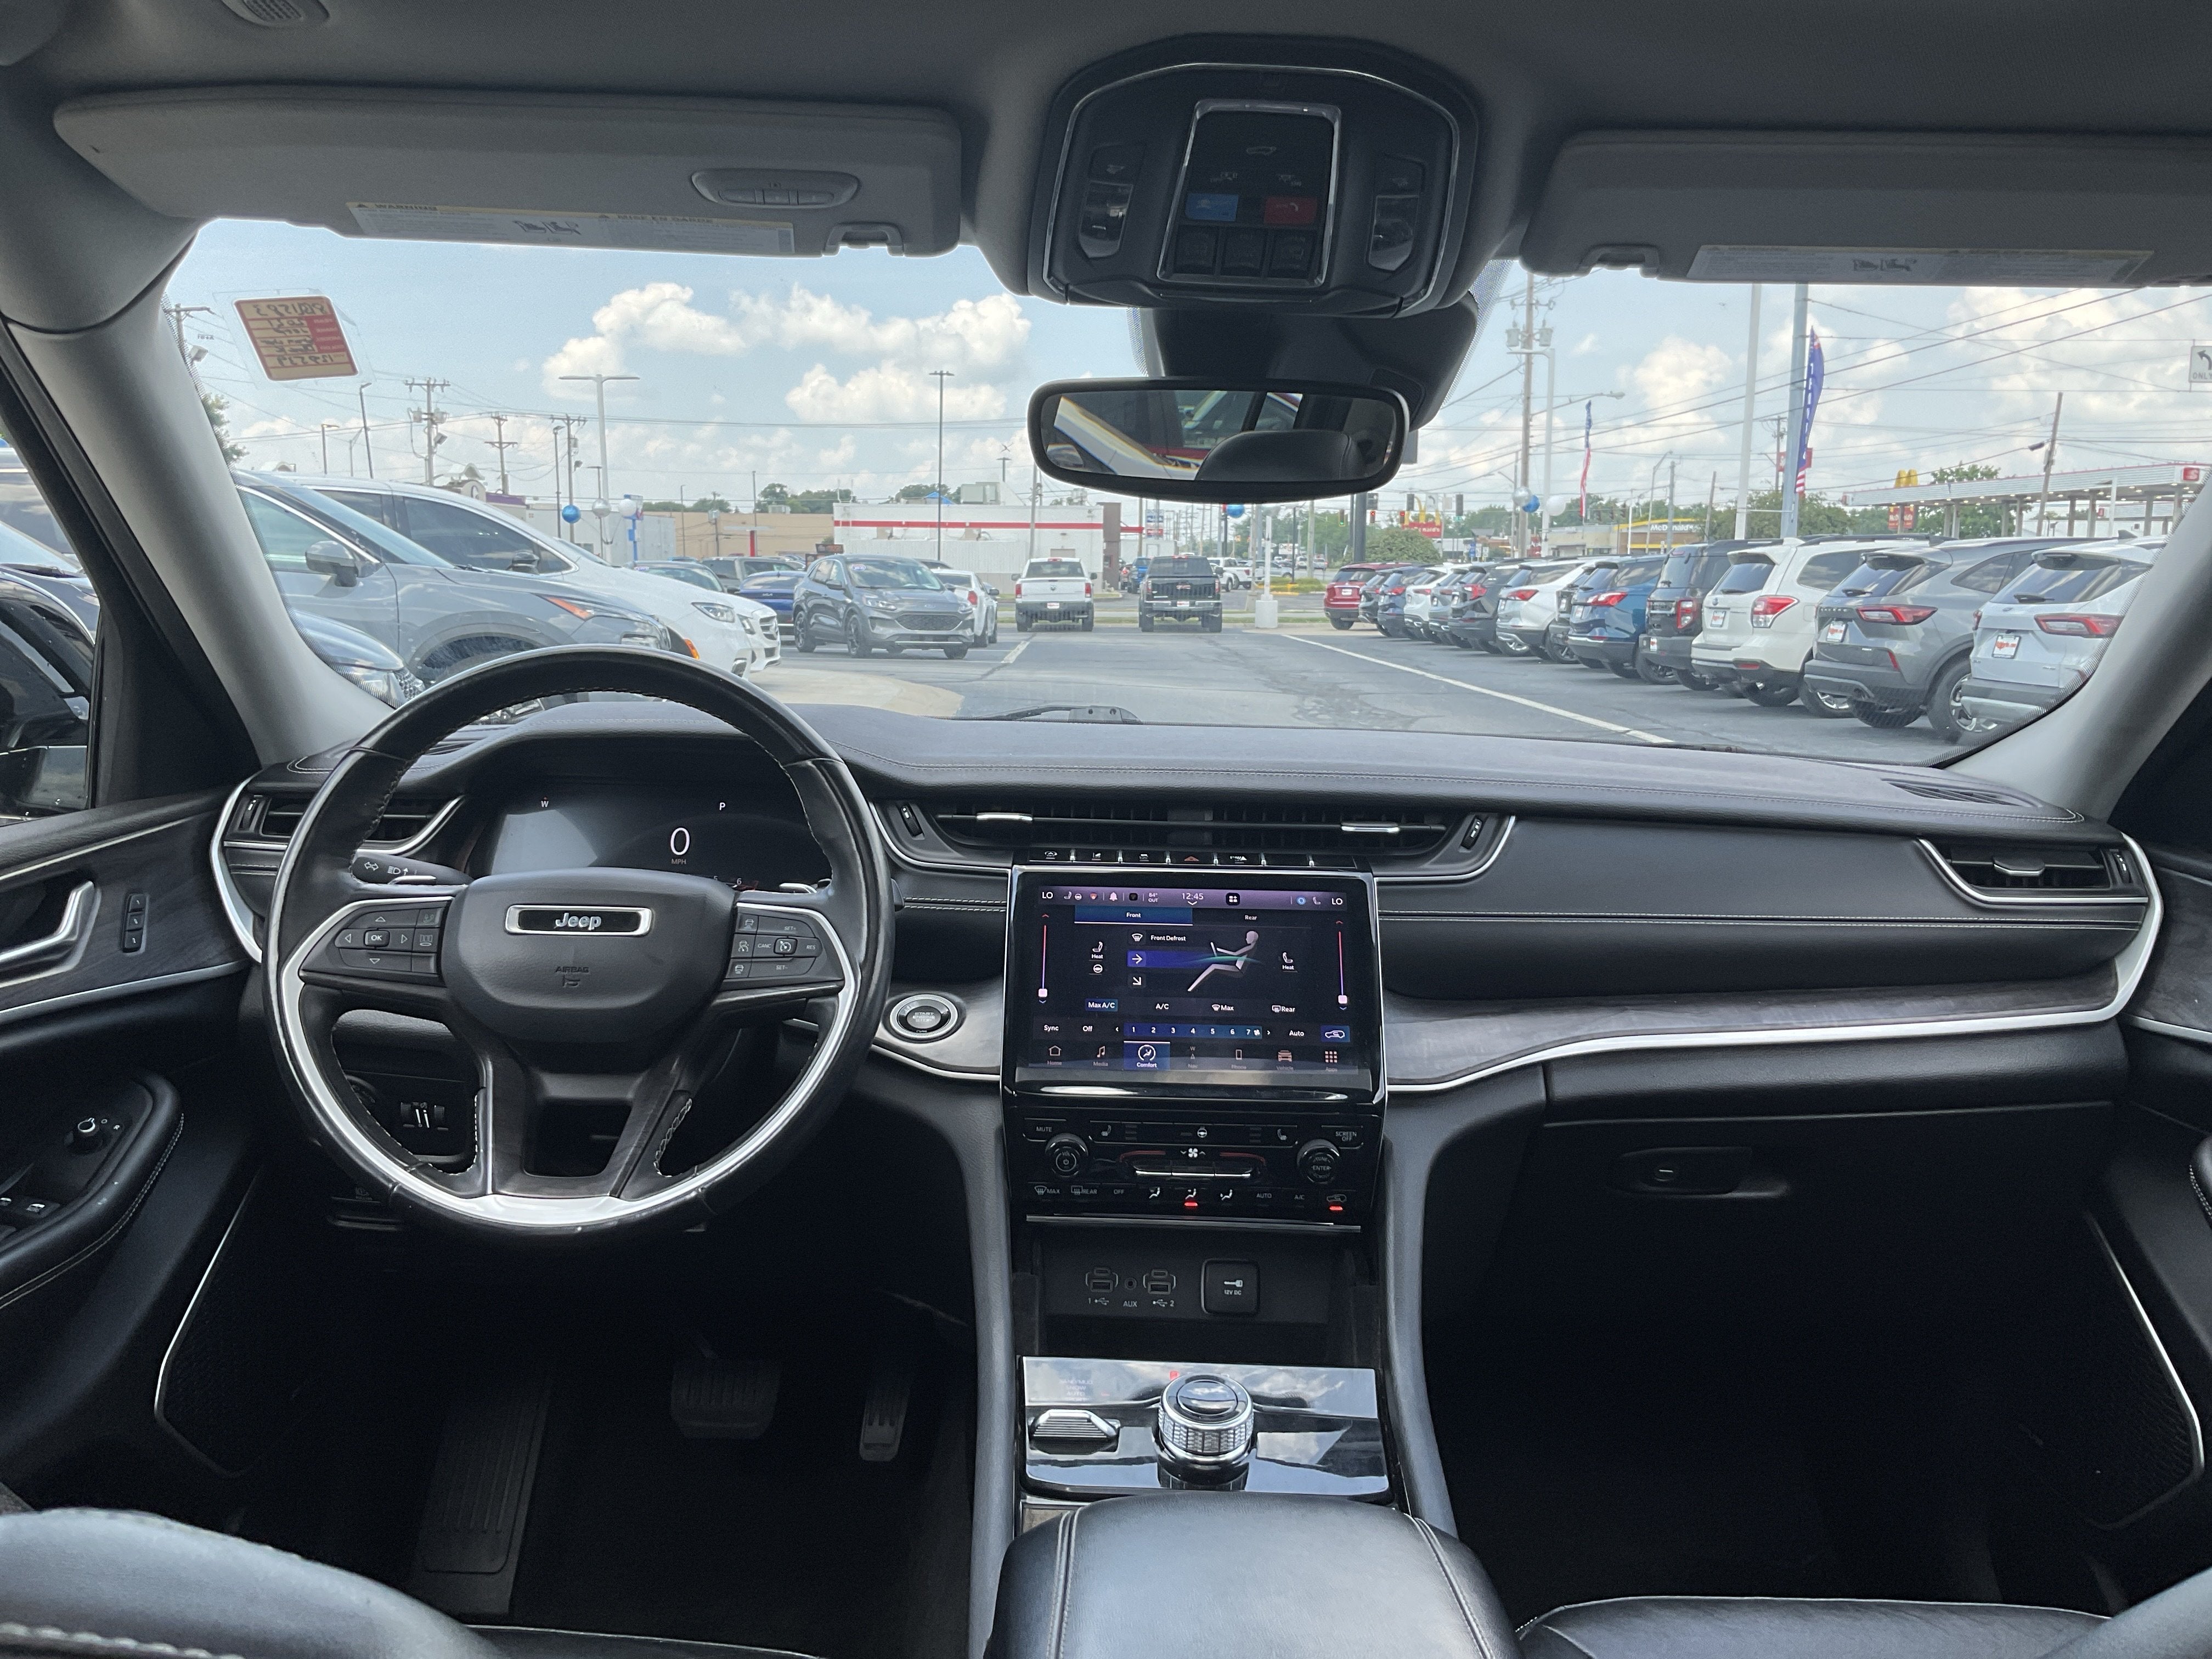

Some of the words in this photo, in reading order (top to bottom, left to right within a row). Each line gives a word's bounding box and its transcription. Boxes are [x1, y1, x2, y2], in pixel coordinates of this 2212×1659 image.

[719, 802, 726, 810] P
[670, 827, 690, 855] 0
[1182, 892, 1204, 900] 12:45
[554, 912, 602, 930] Jeep
